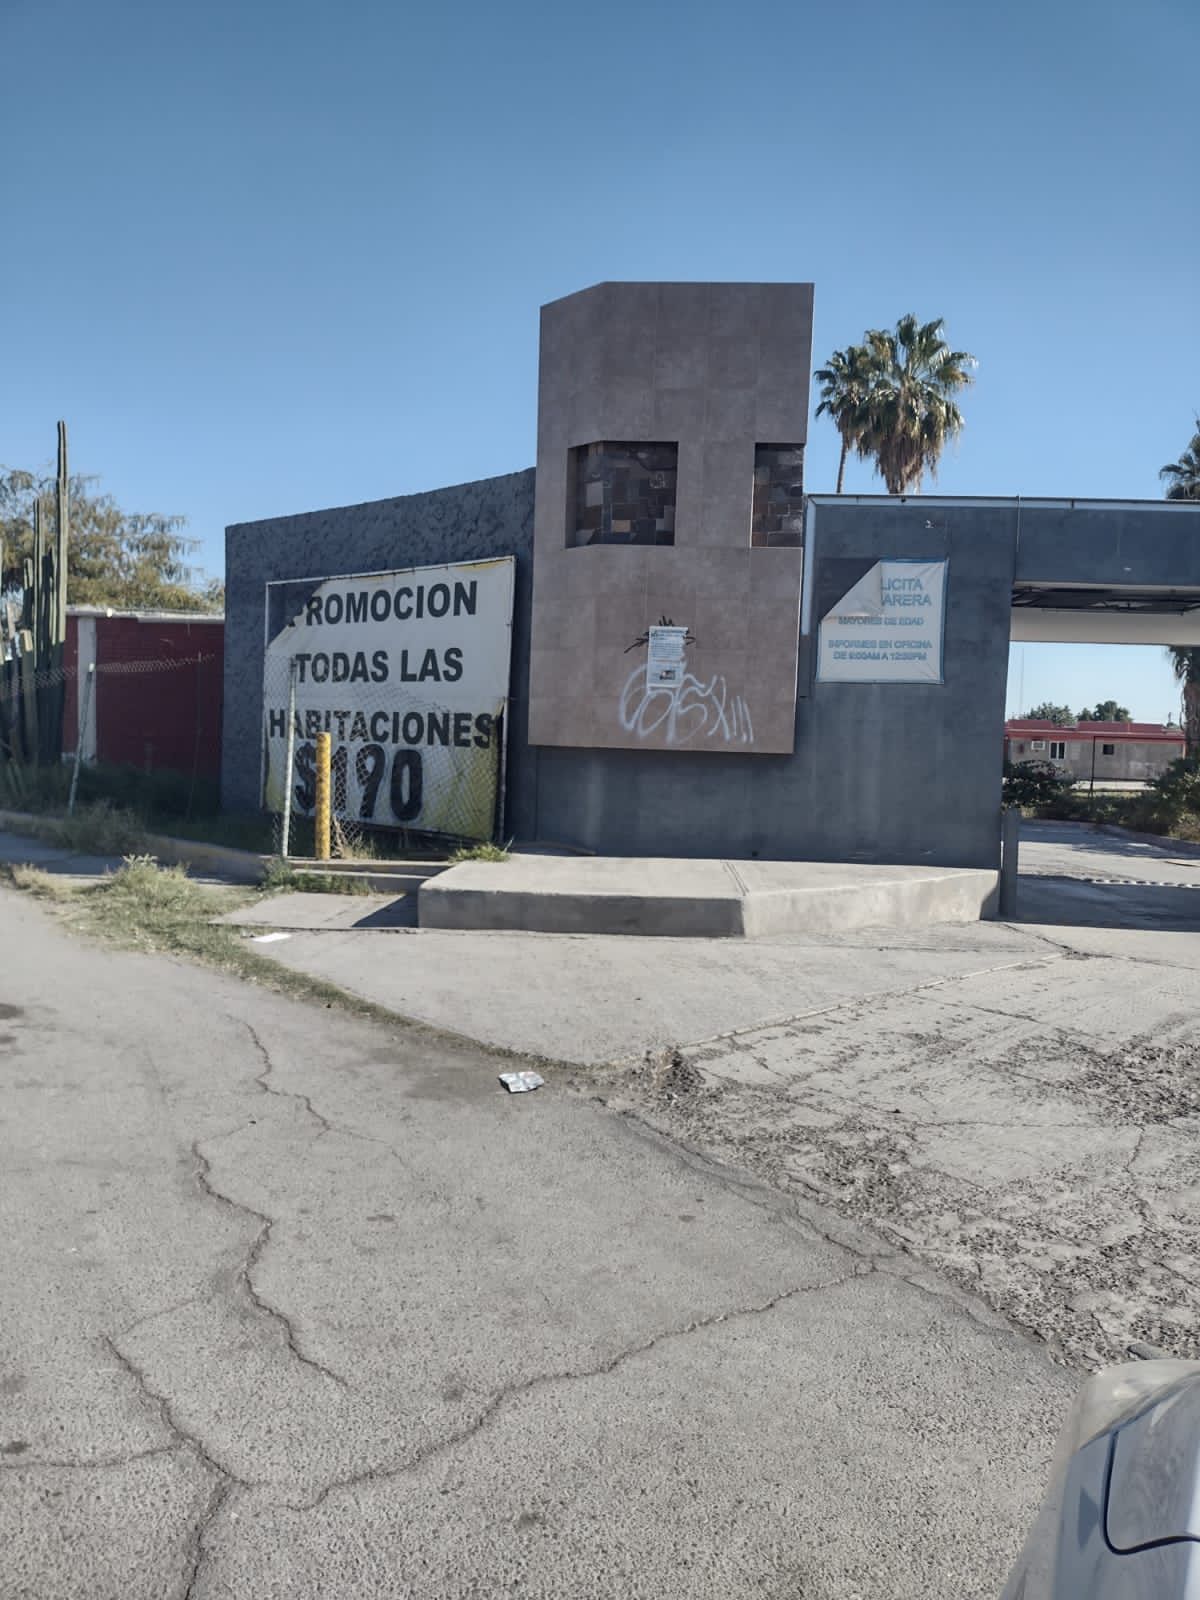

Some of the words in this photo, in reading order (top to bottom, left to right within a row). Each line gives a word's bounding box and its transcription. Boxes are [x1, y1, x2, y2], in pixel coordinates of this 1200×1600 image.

[290, 581, 478, 626] ROMOCION
[880, 595, 931, 606] ARERA
[295, 651, 389, 683] TODAS
[400, 647, 463, 682] LAS
